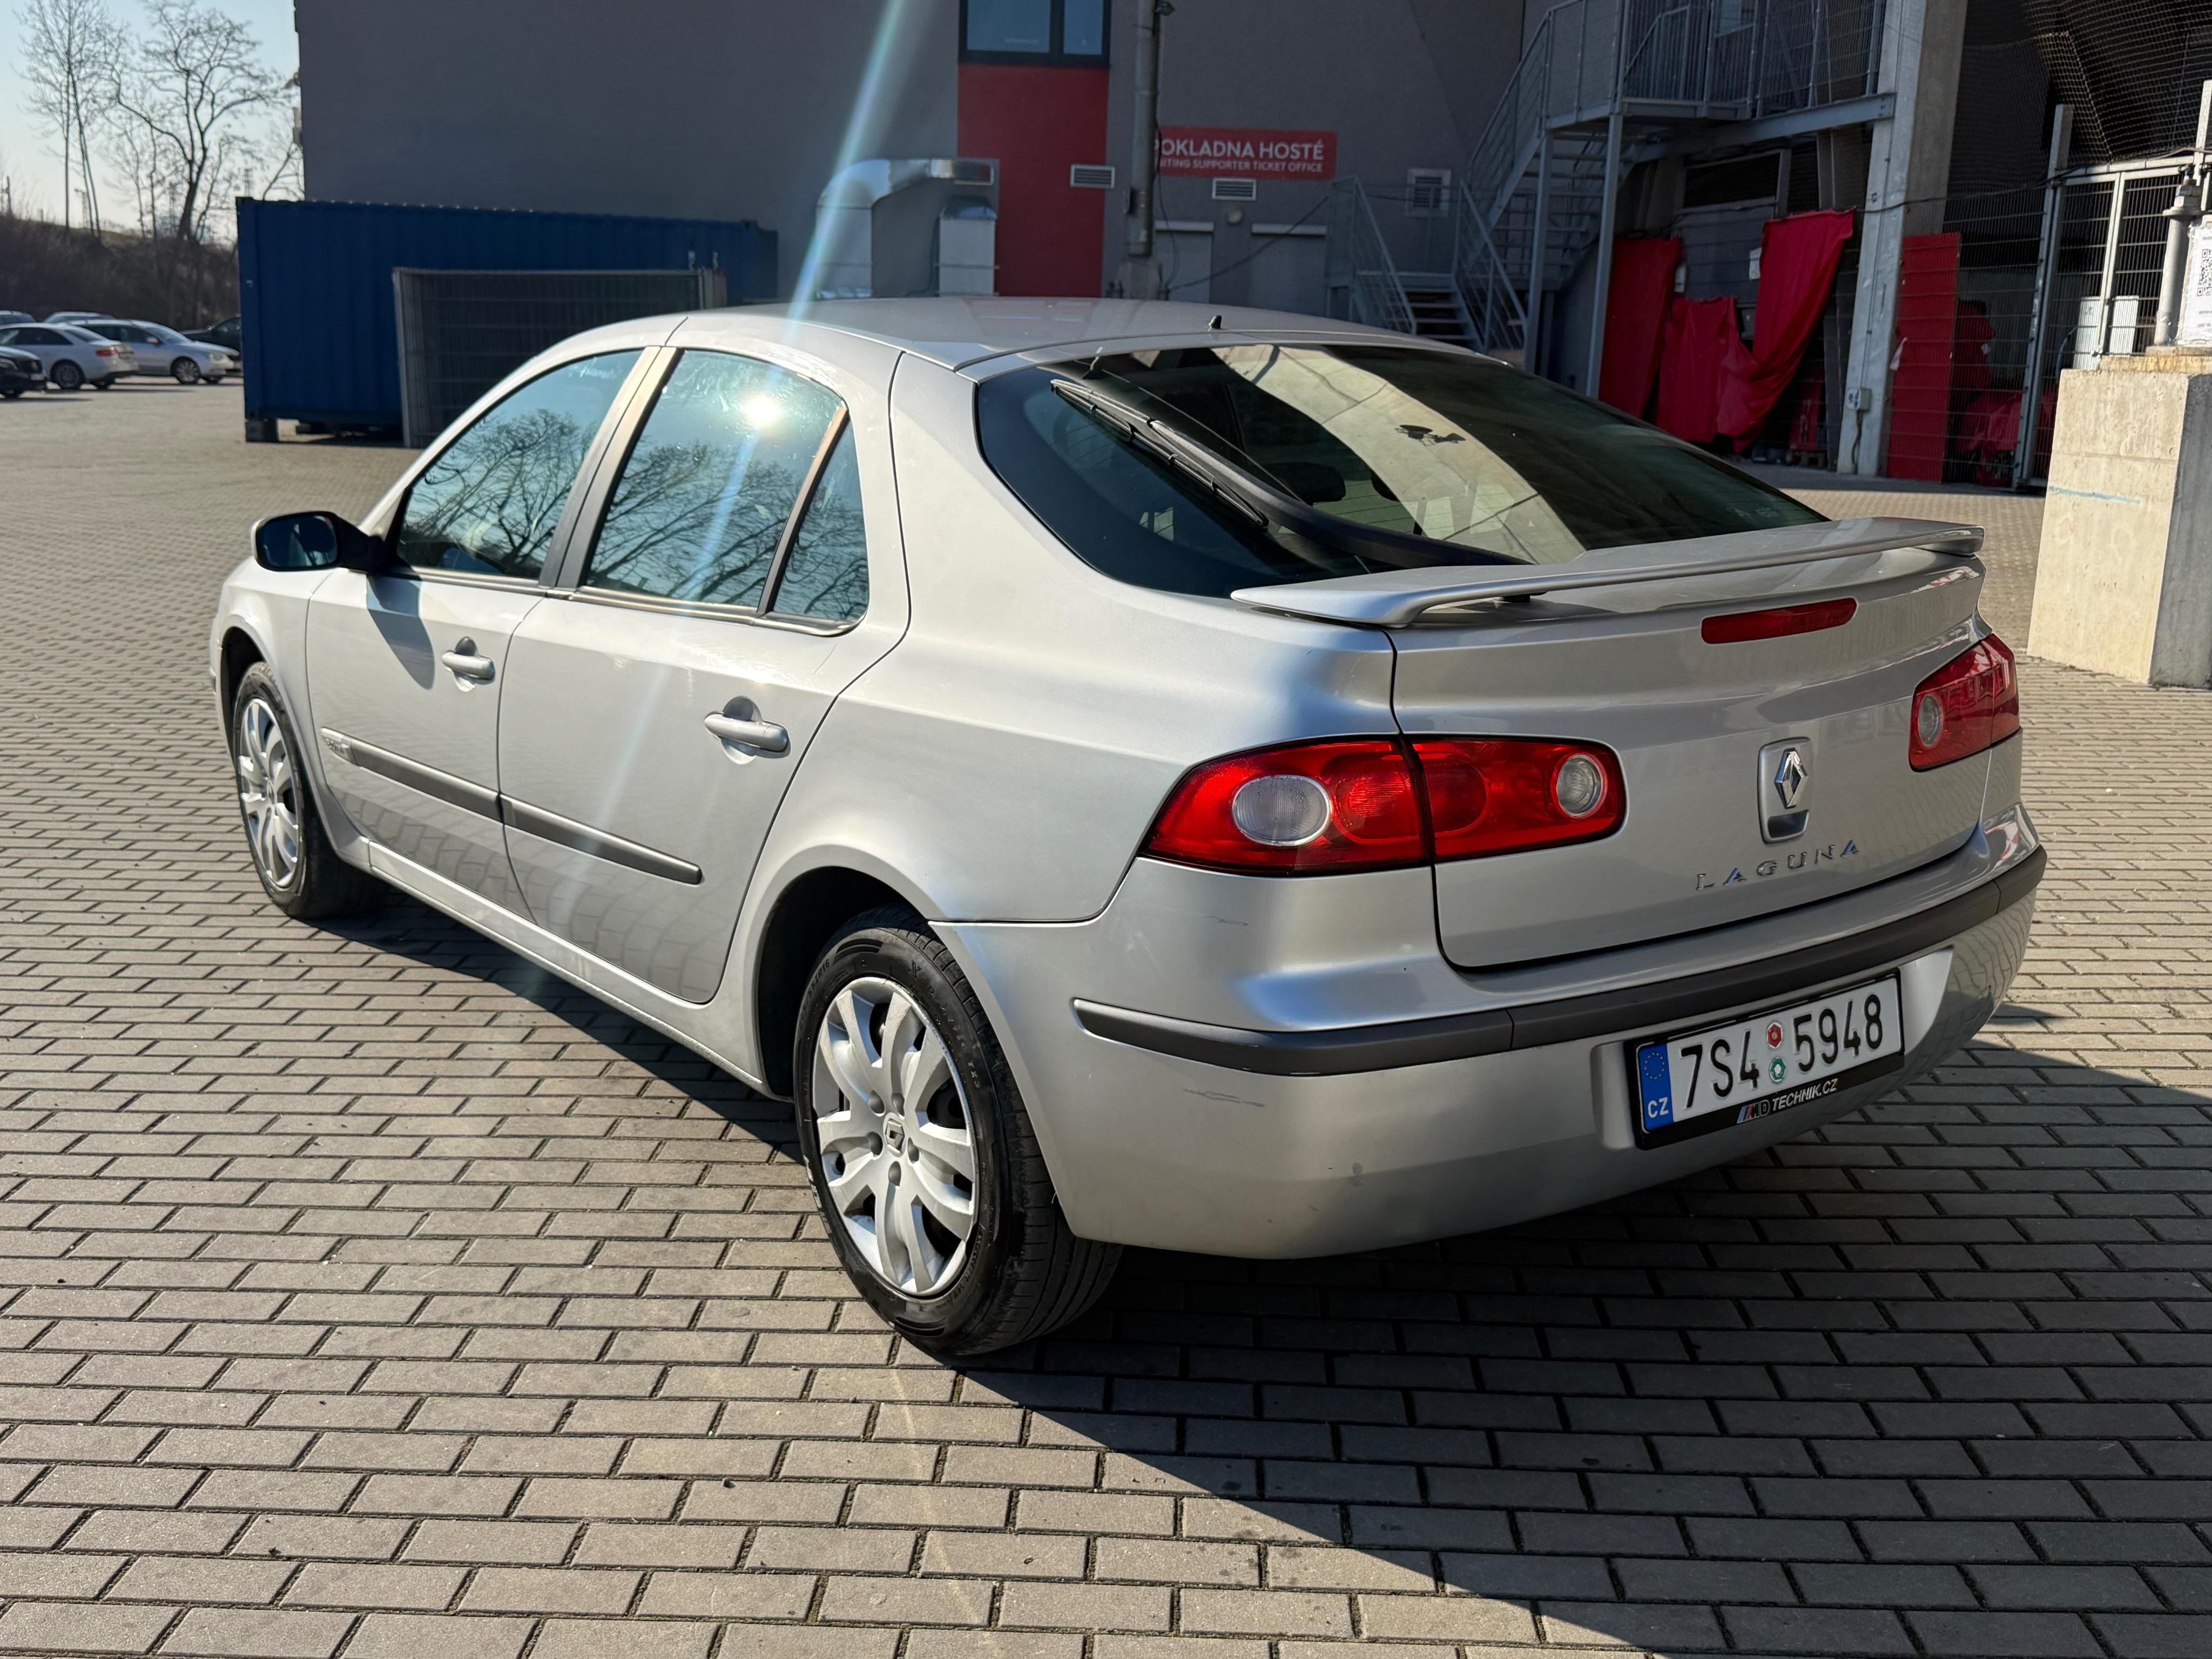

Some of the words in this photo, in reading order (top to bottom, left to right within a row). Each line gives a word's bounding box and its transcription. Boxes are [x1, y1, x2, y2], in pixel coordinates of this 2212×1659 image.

[1259, 140, 1324, 160] HOSTÉ
[1192, 158, 1251, 171] SUPPORTER
[1252, 160, 1287, 172] TICKET
[1288, 162, 1323, 173] OFFICE
[1696, 839, 1859, 891] LAGUNA
[1680, 1030, 1760, 1109] 7S4
[1793, 994, 1883, 1073] 5948
[1648, 1097, 1669, 1119] CZ
